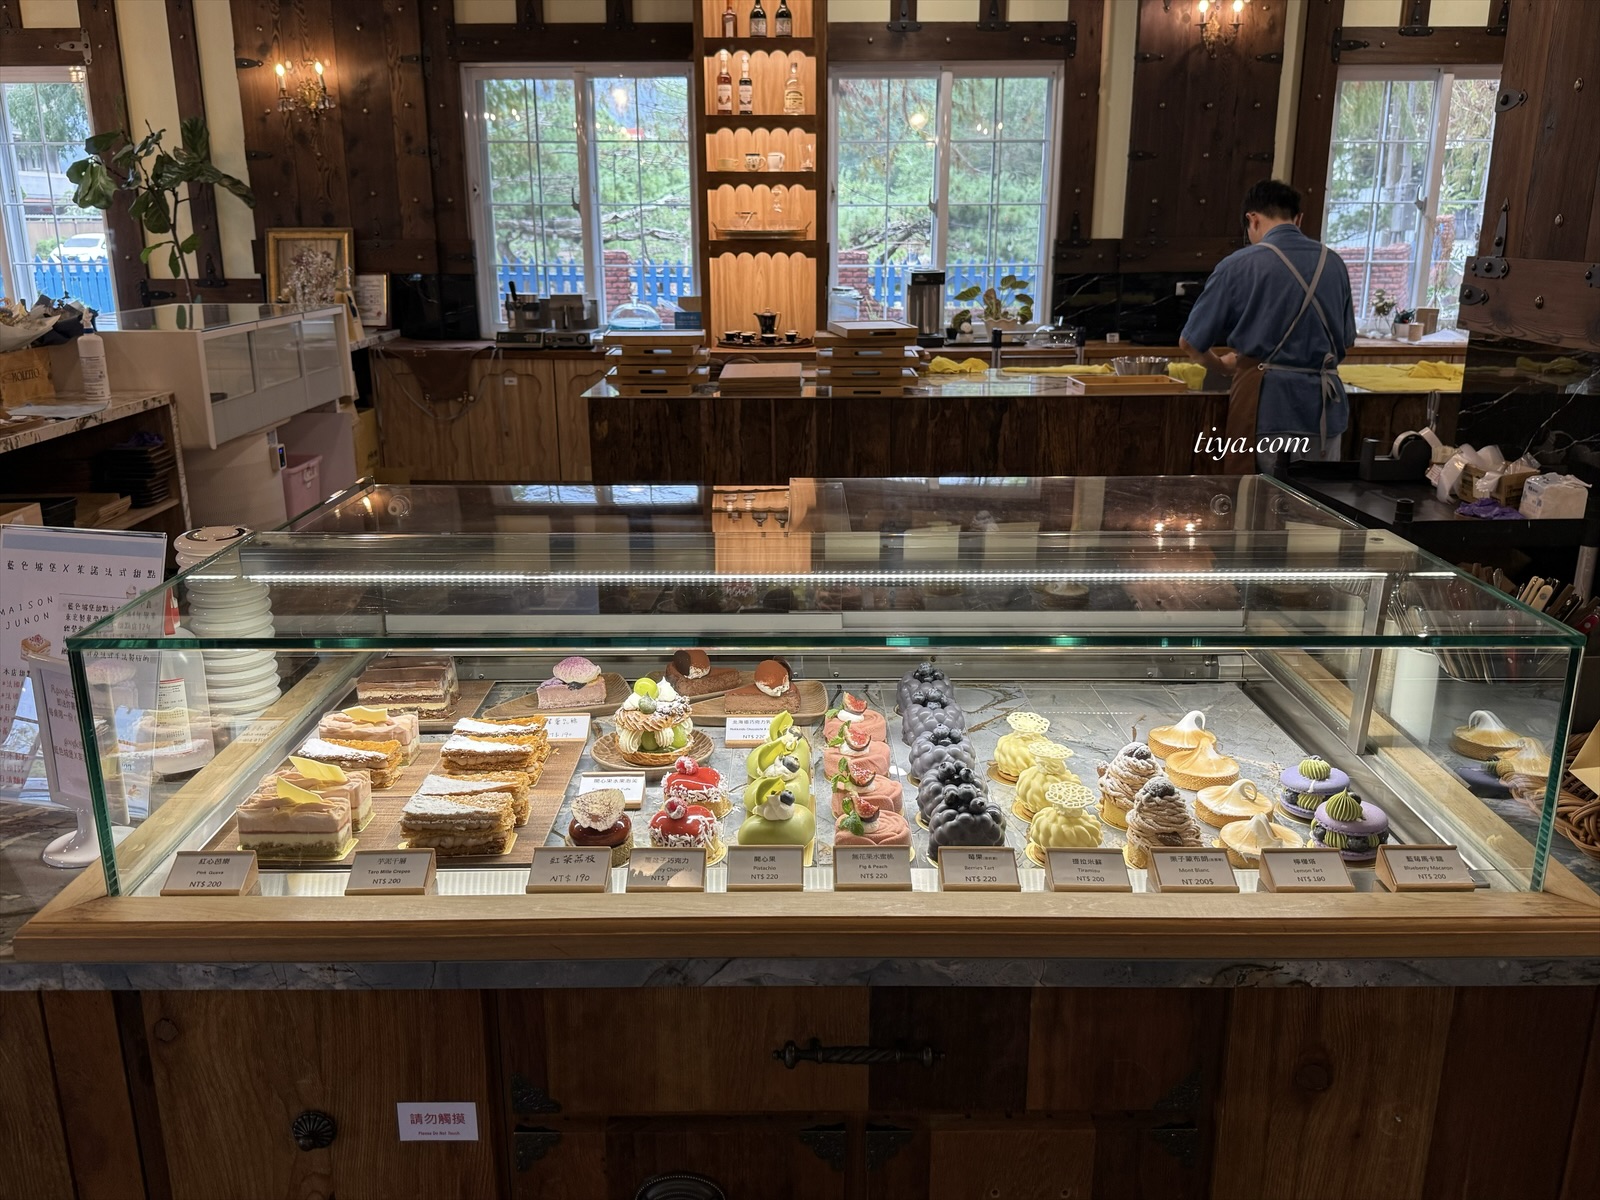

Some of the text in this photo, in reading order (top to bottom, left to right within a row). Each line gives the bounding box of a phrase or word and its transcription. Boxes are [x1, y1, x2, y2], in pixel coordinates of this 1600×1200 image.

[0, 596, 53, 616] MAISON
[6, 612, 50, 630] JUNON
[550, 874, 590, 883] NT$ 190
[410, 1113, 466, 1124] 請勿觸摸
